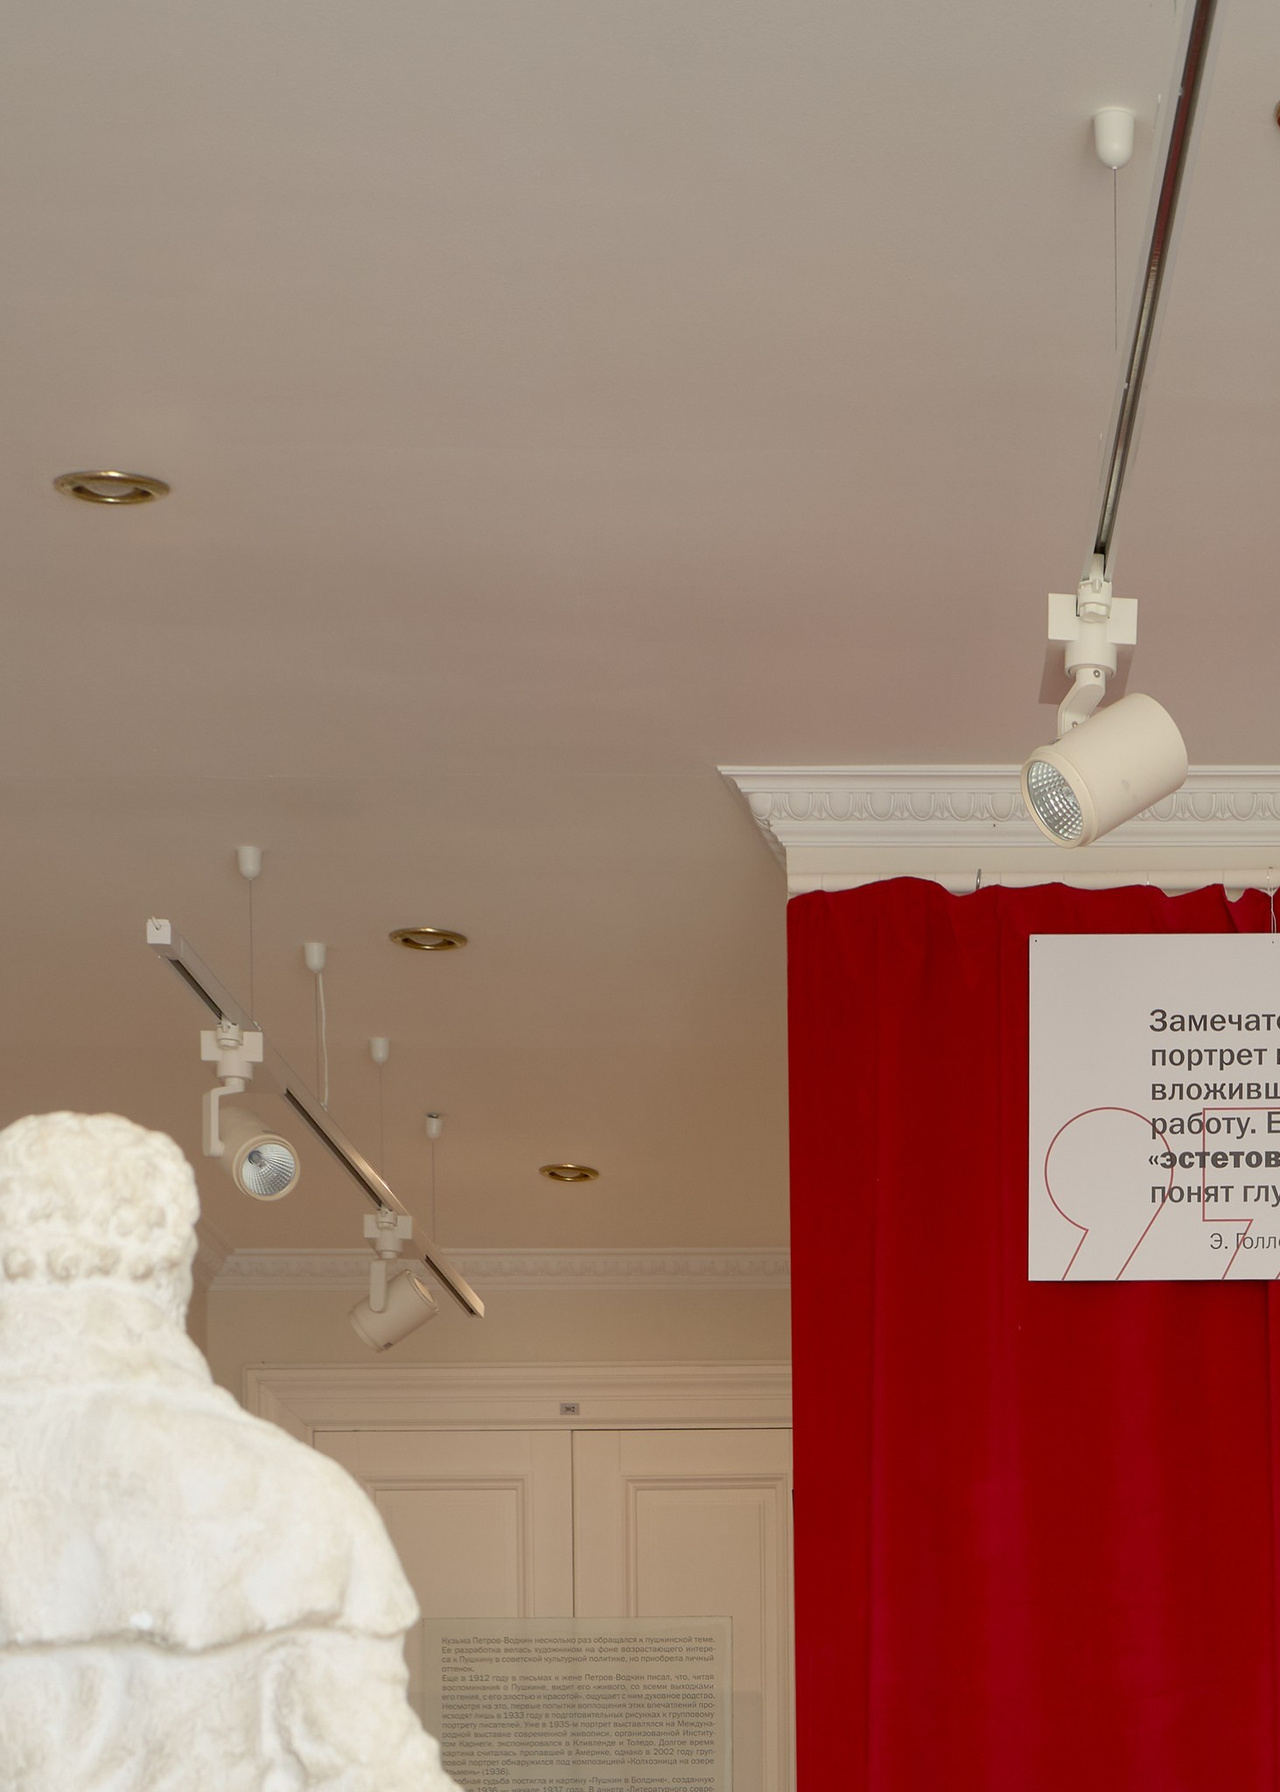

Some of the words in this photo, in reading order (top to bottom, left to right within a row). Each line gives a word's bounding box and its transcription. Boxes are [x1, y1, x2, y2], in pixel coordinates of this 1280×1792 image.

[1151, 1048, 1268, 1071] портрет
[1150, 1111, 1257, 1141] работу.
[1151, 1183, 1235, 1205] понят
[1209, 1232, 1229, 1250] Э.
